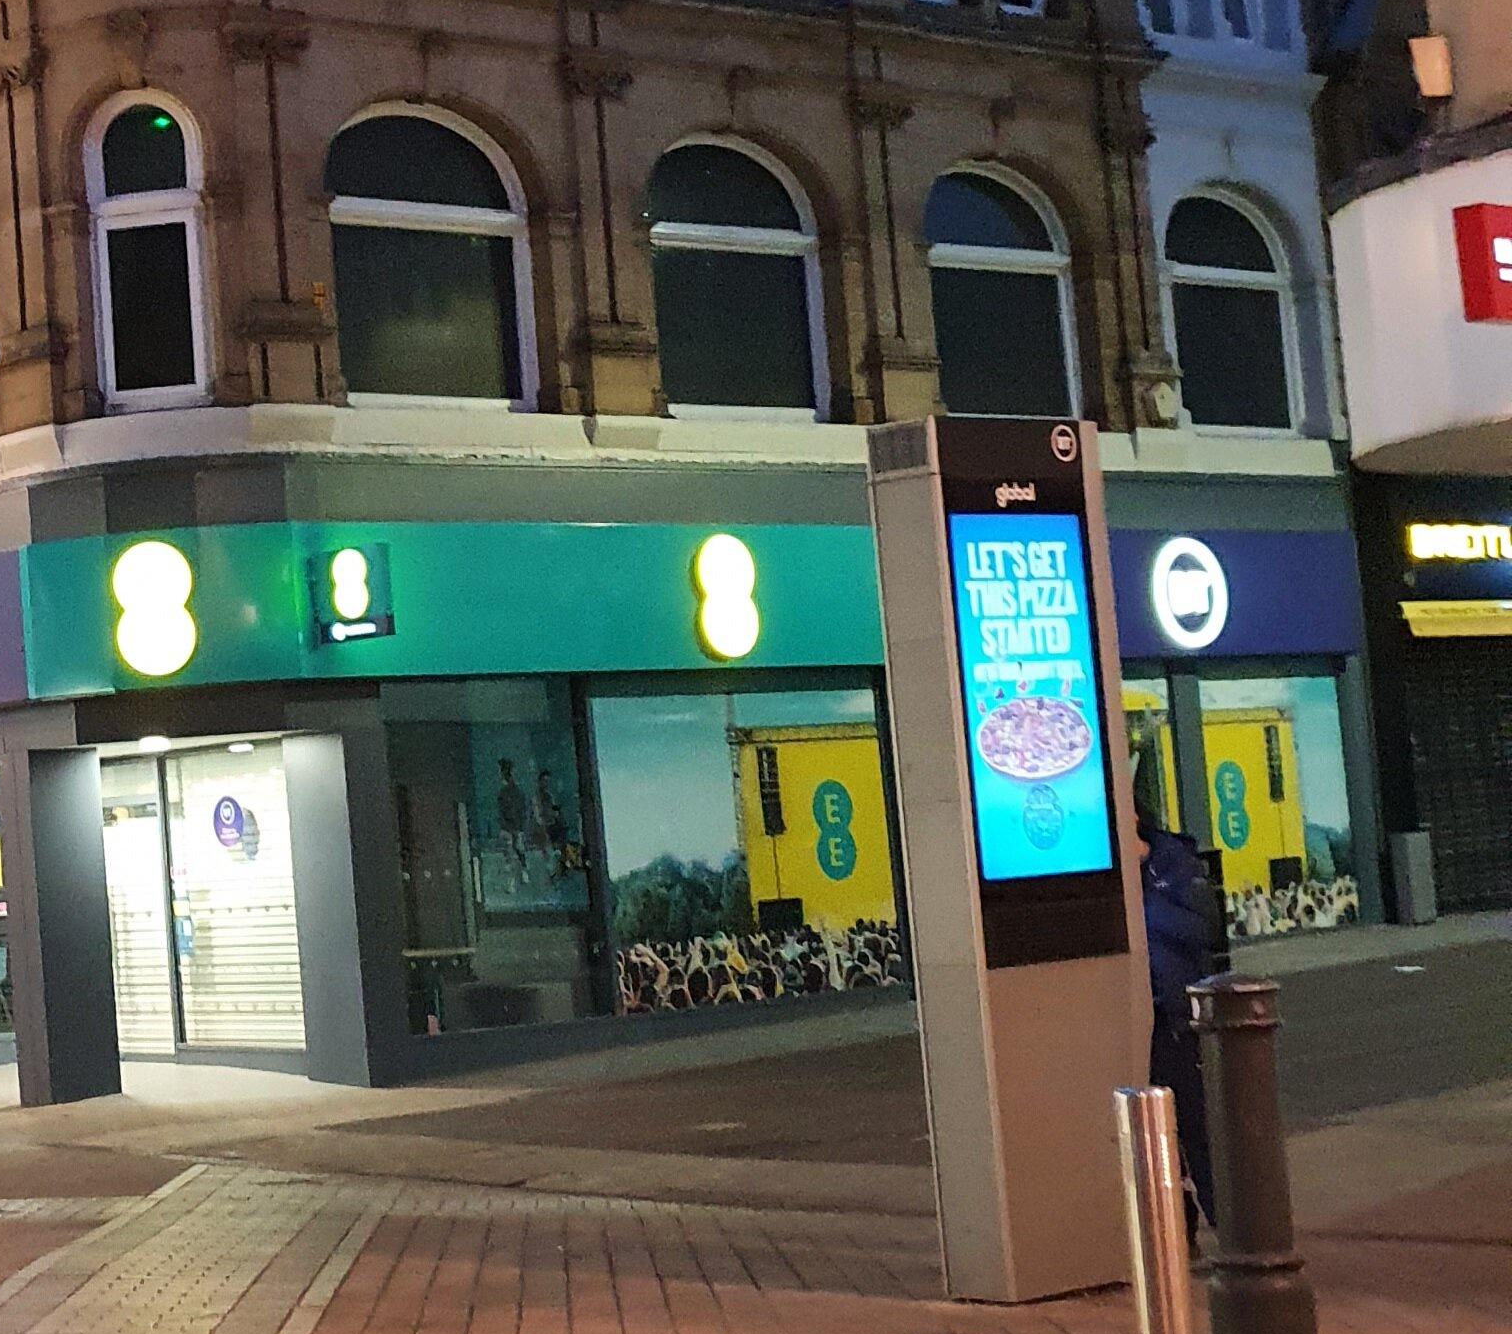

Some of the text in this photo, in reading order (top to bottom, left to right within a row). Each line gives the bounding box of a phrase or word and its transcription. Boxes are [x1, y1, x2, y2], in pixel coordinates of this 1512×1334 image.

[994, 482, 1036, 508] global
[966, 541, 1067, 579] LET'S GET
[964, 579, 1079, 617] THIS PIZZA
[979, 618, 1071, 656] STARTED
